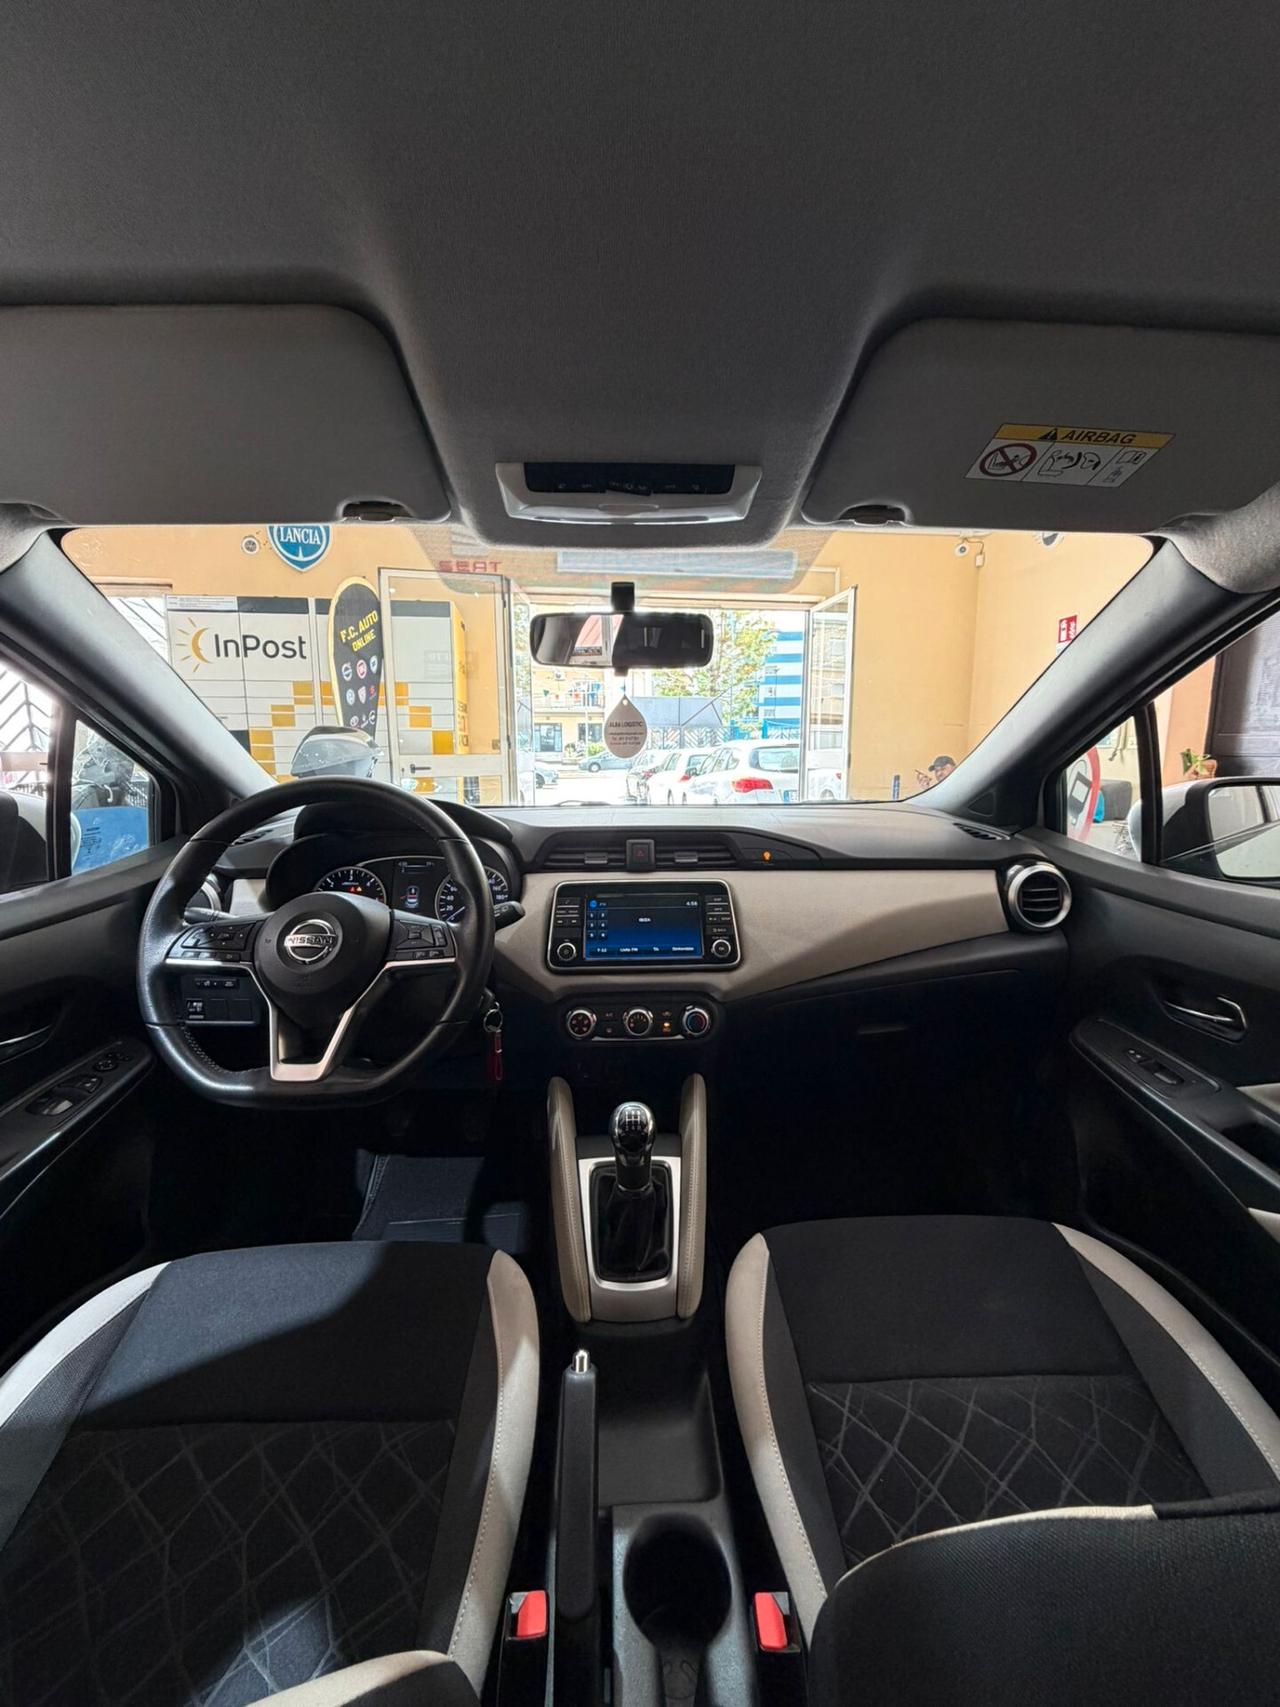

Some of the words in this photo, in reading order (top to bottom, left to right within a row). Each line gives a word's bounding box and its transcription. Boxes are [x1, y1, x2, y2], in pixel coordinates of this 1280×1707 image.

[1061, 429, 1137, 445] AIRBAG
[279, 526, 321, 545] LANCIA
[439, 560, 503, 573] SEAT
[340, 626, 359, 643] F.C.
[358, 610, 379, 633] AUTO
[214, 633, 307, 660] InPost
[351, 629, 377, 652] ONLINE
[288, 936, 334, 946] NISSAN
